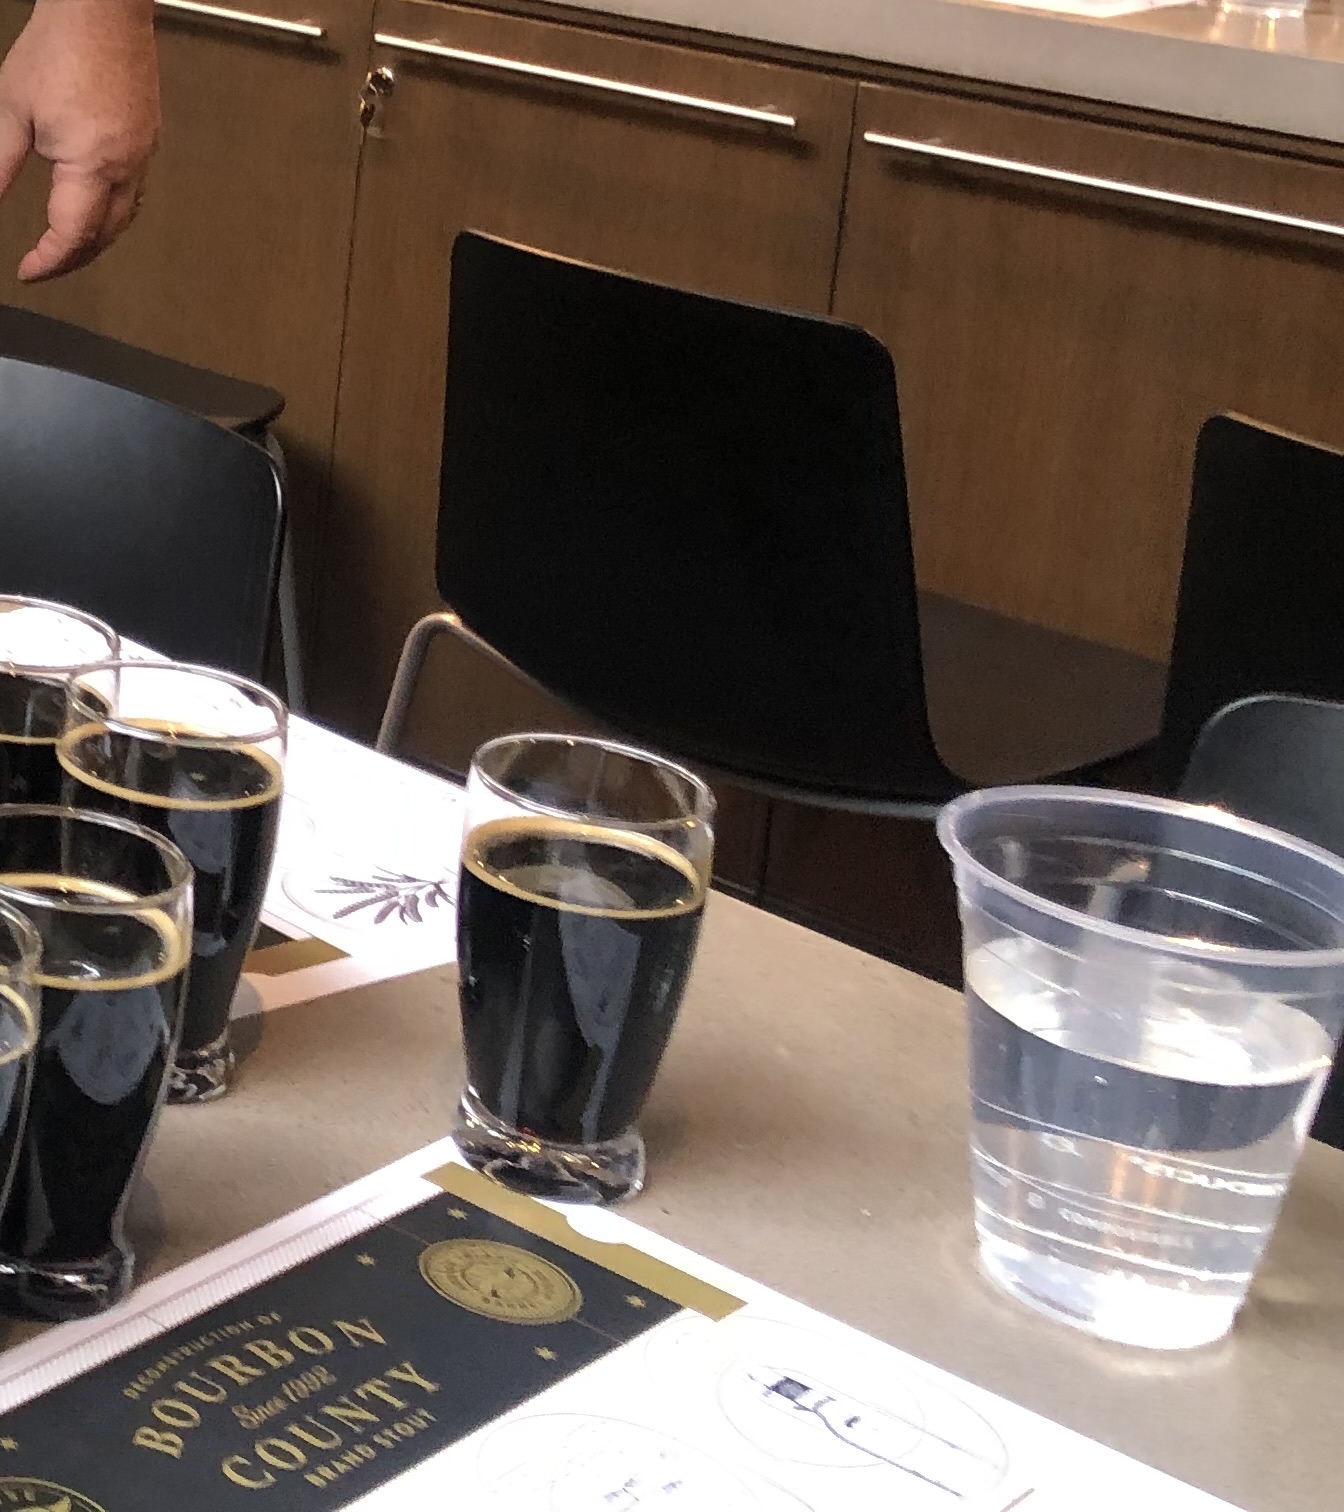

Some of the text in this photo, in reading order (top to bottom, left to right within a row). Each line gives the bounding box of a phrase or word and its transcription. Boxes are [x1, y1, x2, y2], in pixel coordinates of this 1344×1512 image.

[122, 1319, 256, 1400] DECONSTRUCTION
[131, 1316, 389, 1460] BOURBON
[220, 1359, 442, 1490] COUNTY
[230, 1395, 289, 1431] Since
[302, 1406, 438, 1489] BRAND STOUT
